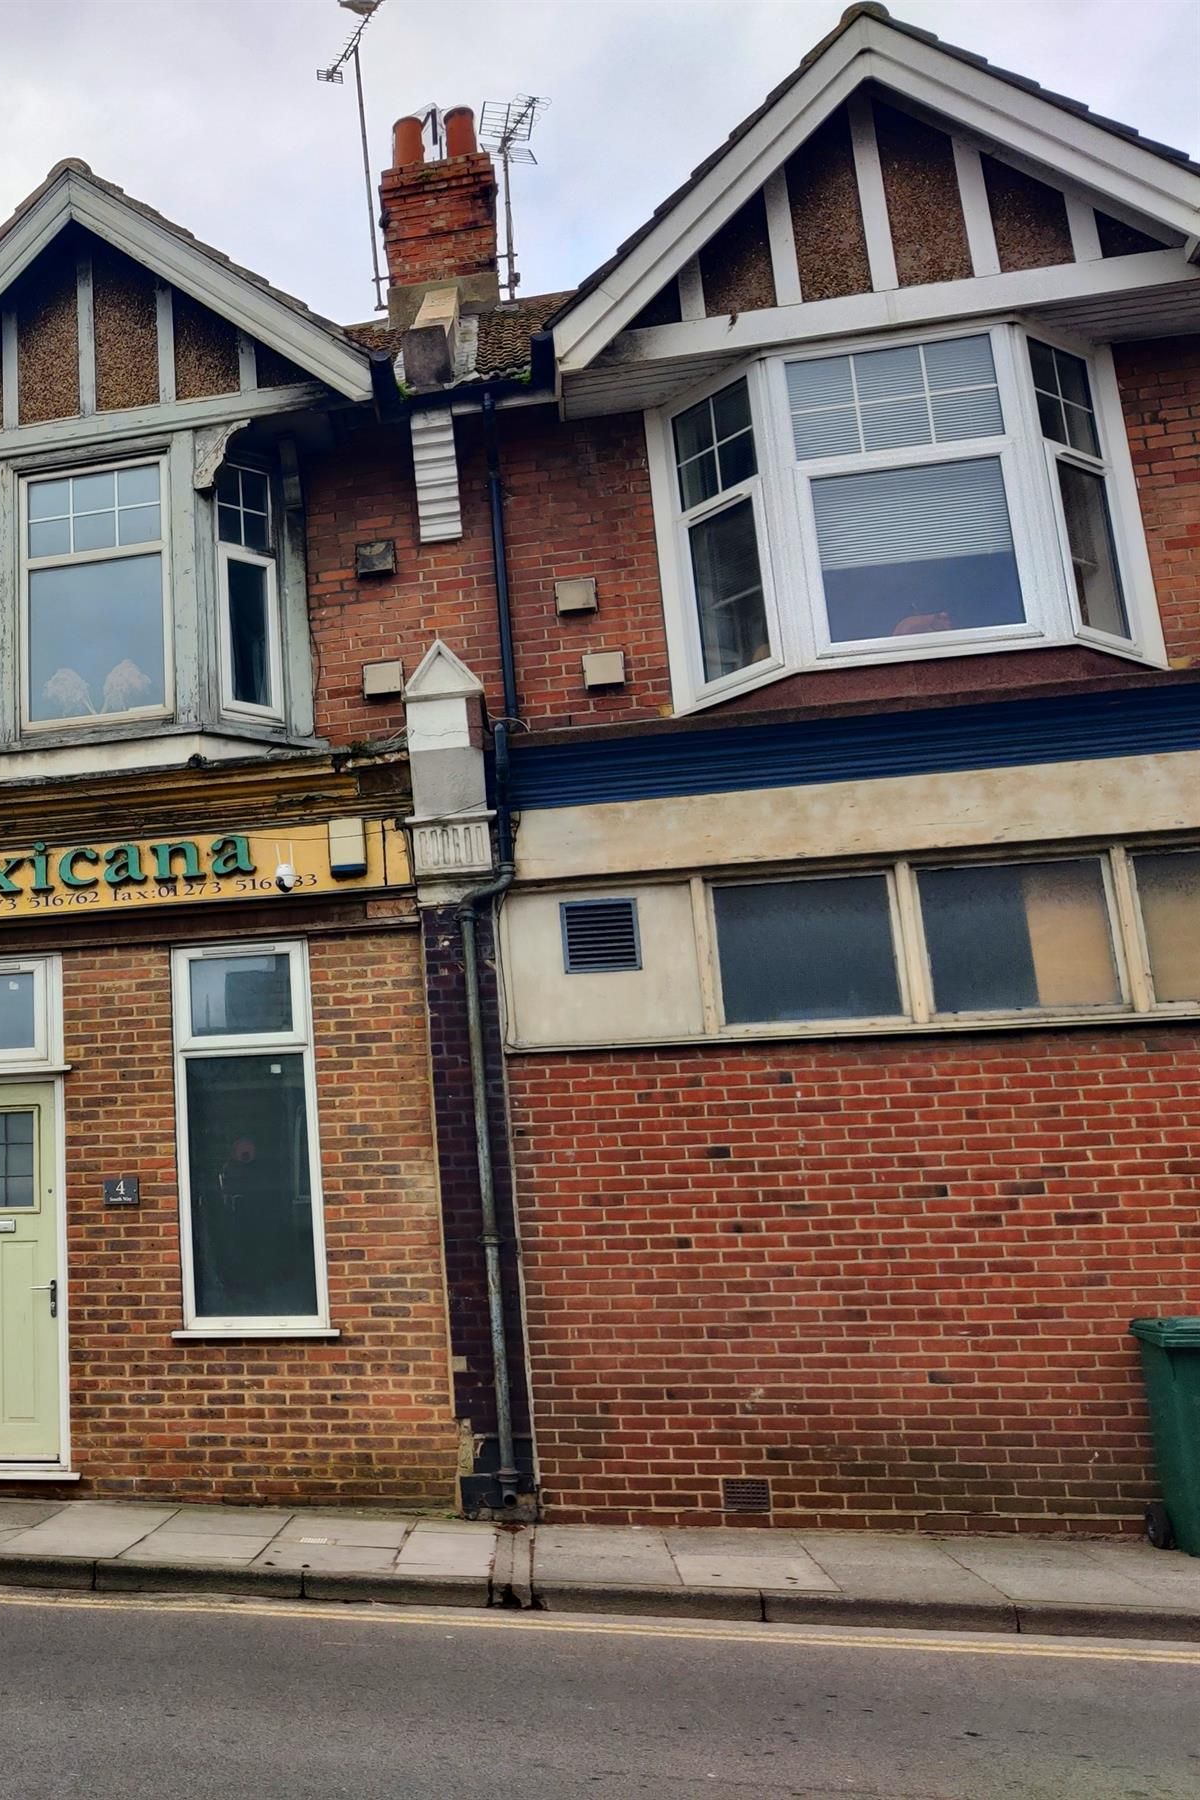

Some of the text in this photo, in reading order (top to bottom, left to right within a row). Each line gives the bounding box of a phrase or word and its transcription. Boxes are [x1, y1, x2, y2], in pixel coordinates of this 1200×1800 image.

[28, 890, 99, 909] 516762
[113, 880, 222, 901] fax:01273
[235, 873, 318, 893] 51633
[116, 1180, 125, 1195] 4
